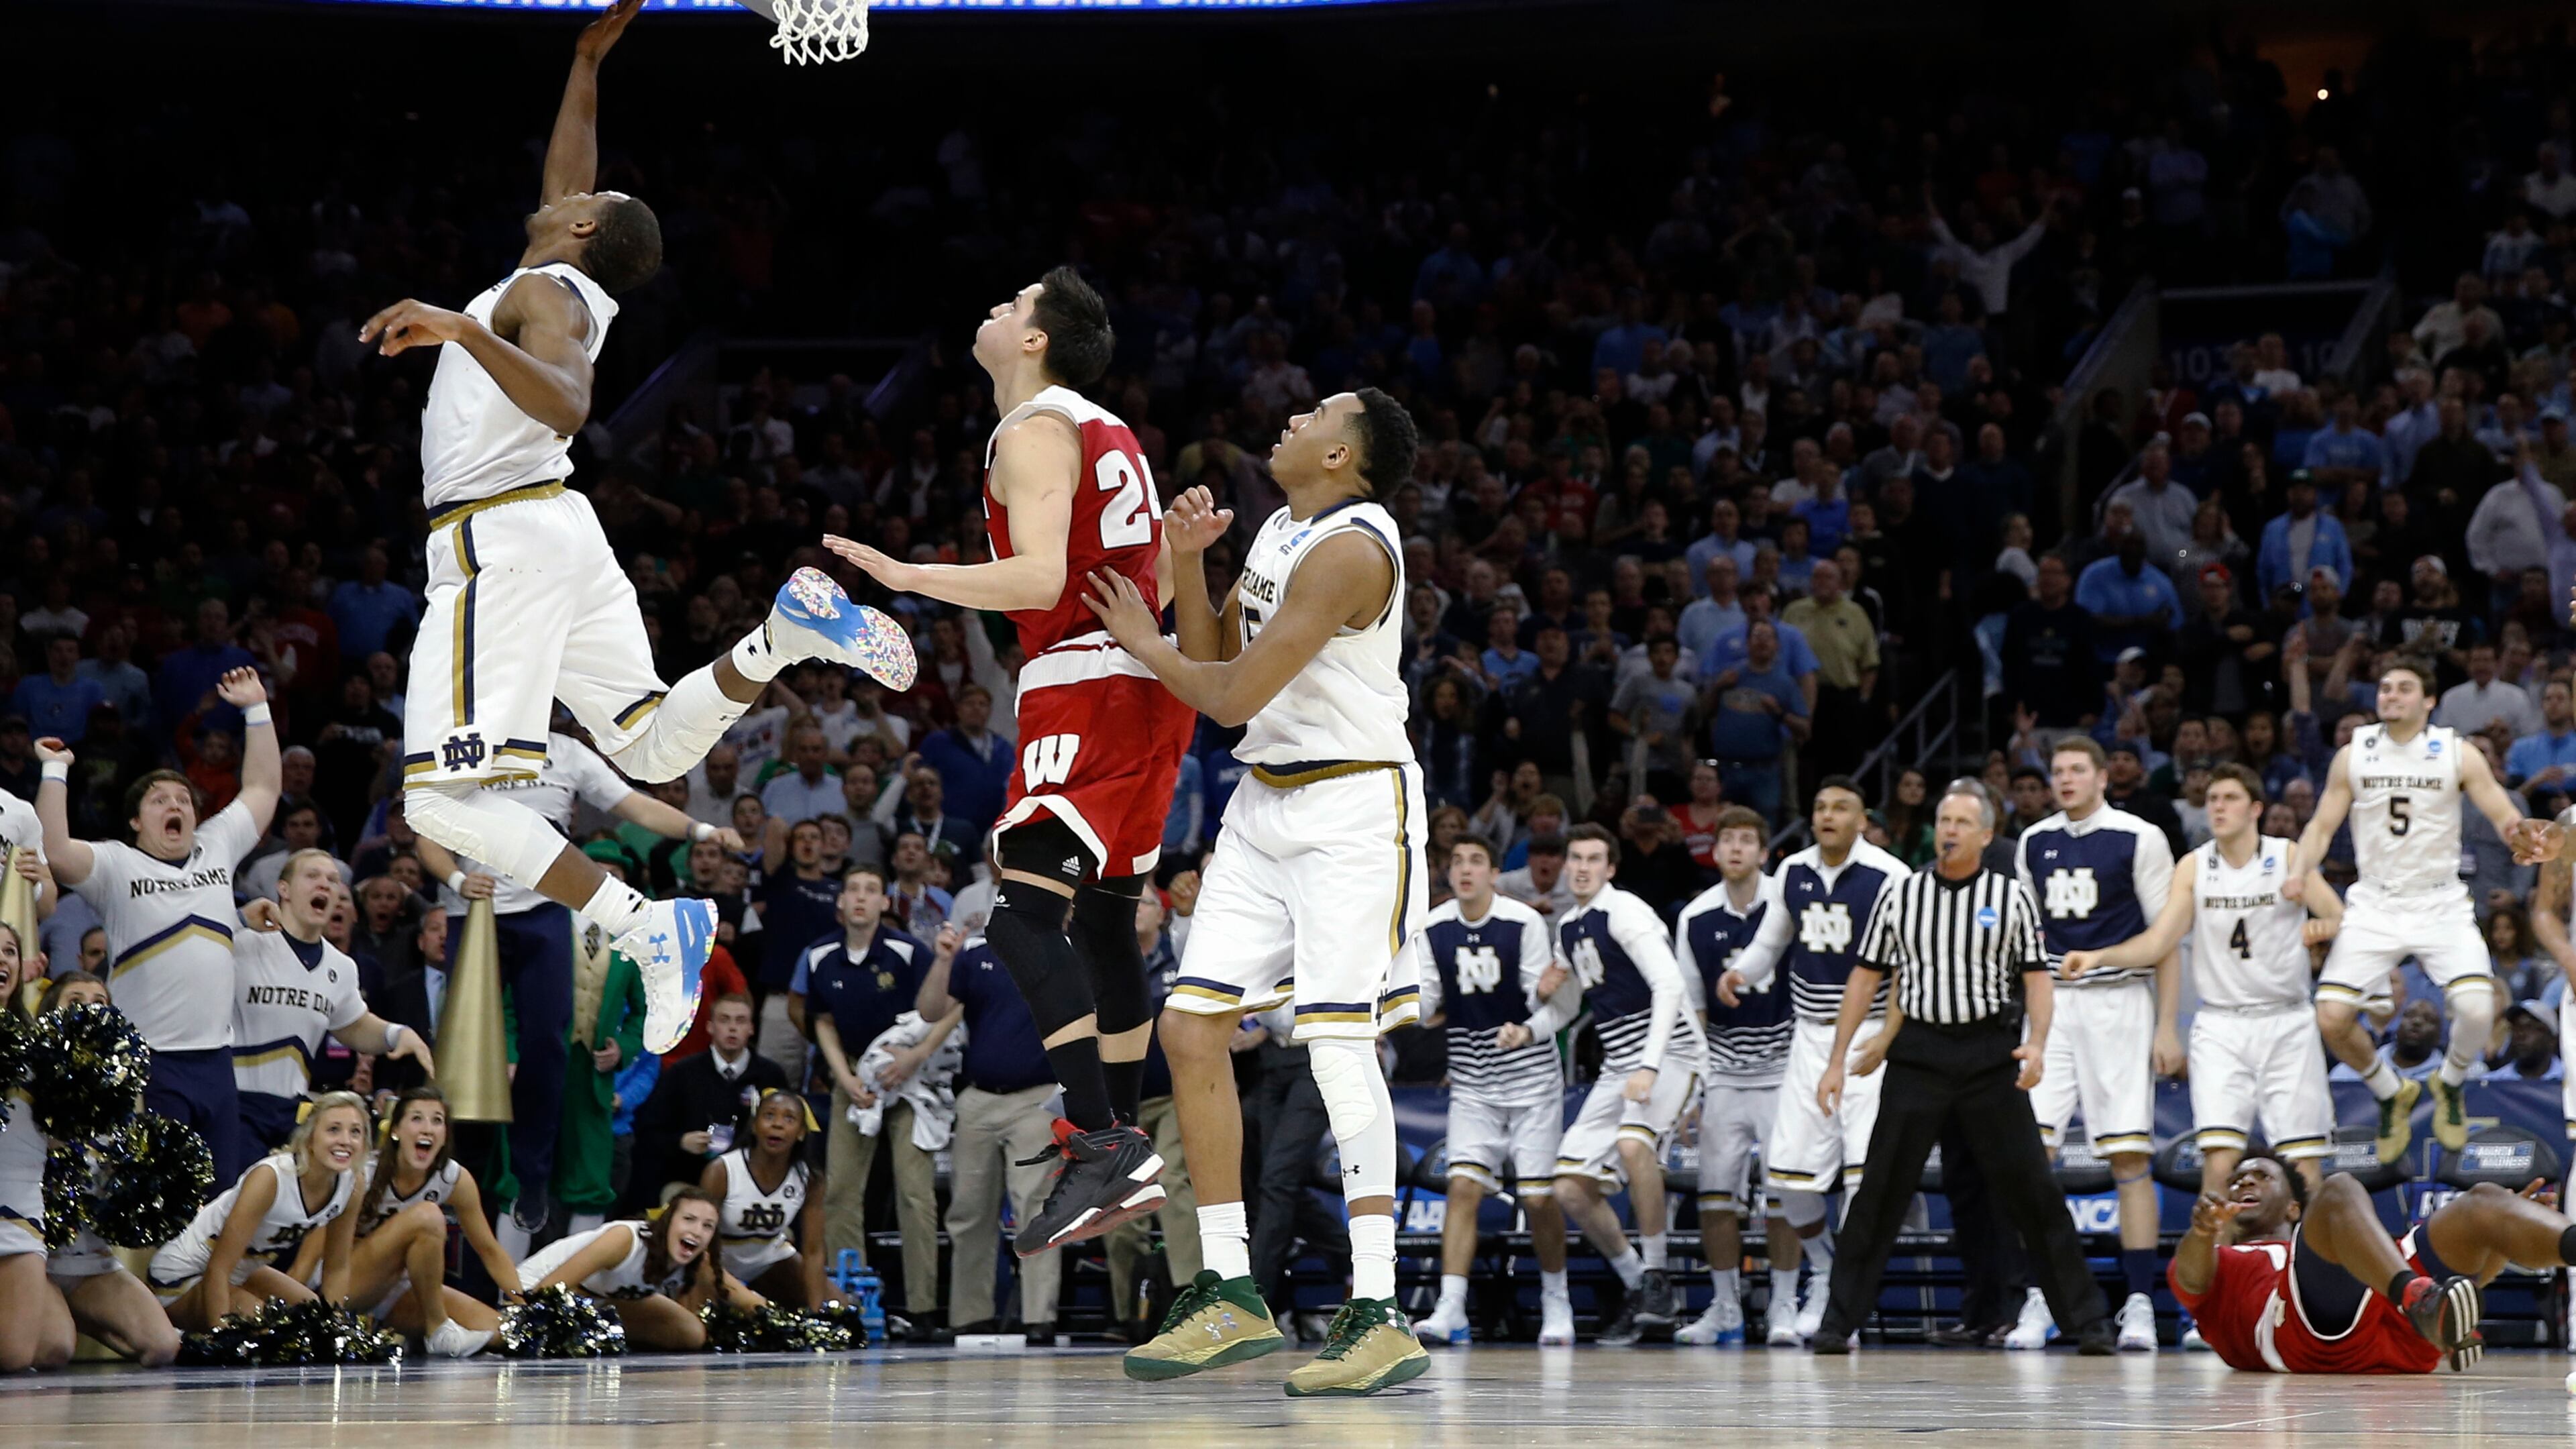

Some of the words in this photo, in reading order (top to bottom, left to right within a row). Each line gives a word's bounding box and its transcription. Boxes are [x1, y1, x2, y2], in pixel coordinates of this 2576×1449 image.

[1022, 733, 1081, 795] W
[2389, 796, 2411, 837] 5
[2230, 916, 2251, 960] 4
[247, 985, 309, 1008] NOTRE
